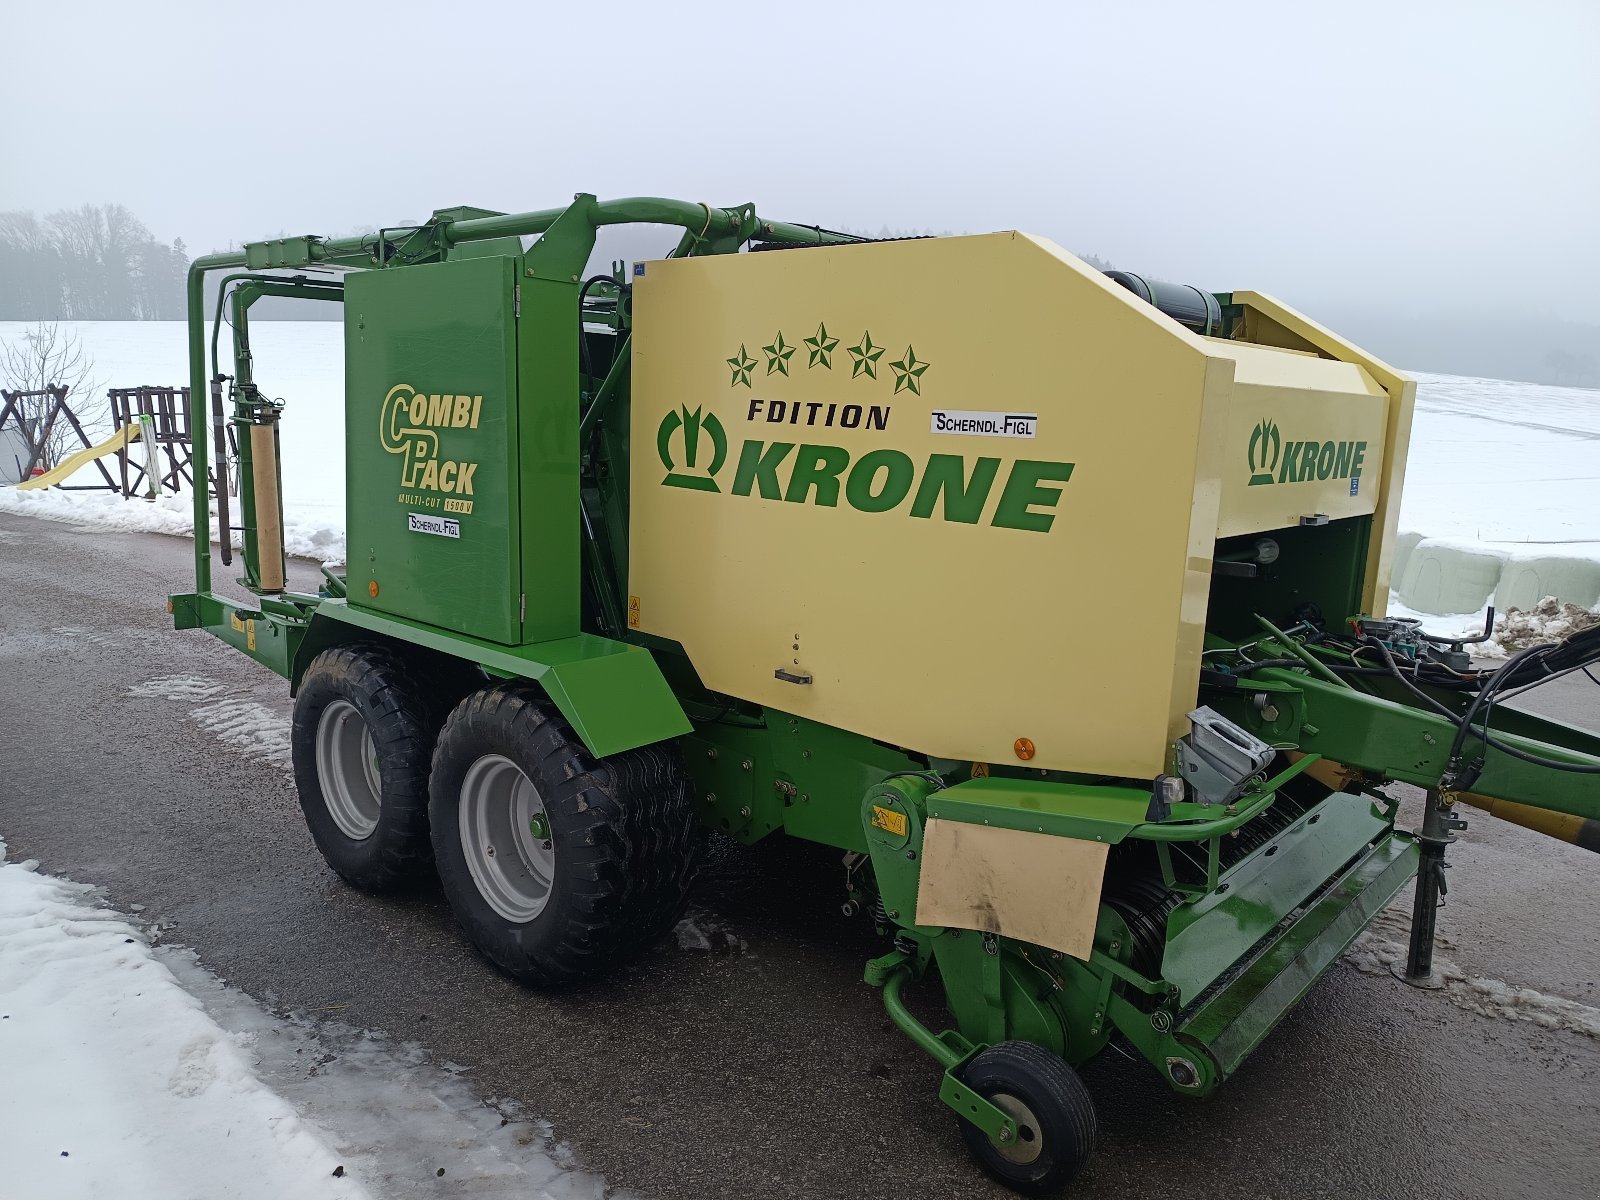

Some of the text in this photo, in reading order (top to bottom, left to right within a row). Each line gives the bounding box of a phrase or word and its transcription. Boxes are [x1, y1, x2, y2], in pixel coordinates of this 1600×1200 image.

[380, 383, 483, 453] COMBI
[401, 428, 478, 495] PACK
[730, 439, 1076, 533] KRONE
[1278, 440, 1367, 484] KRONE
[398, 493, 440, 508] MULTI-CUT
